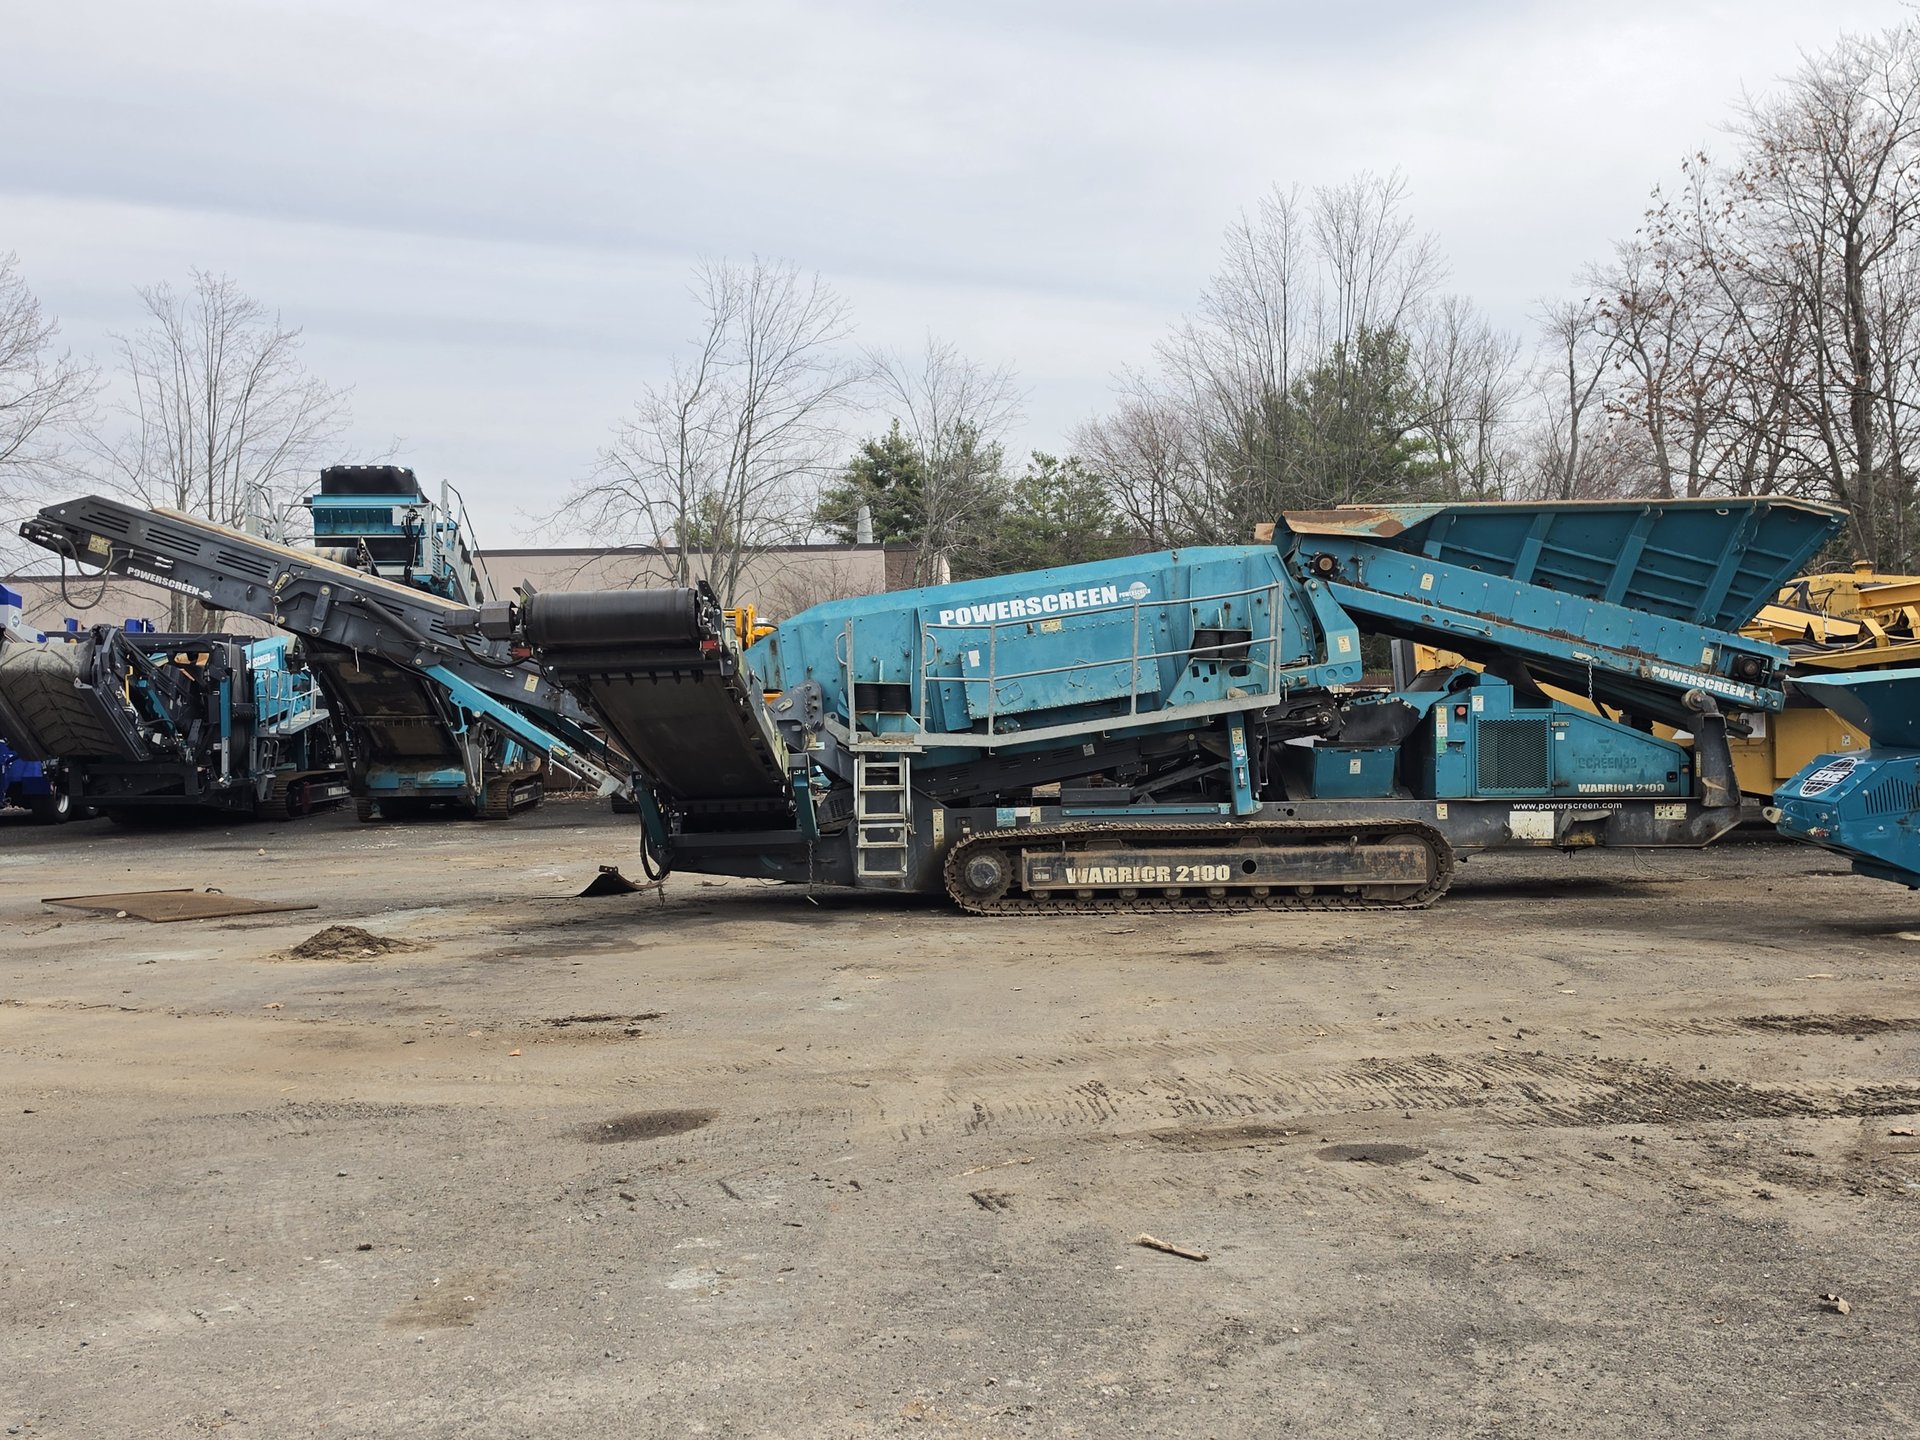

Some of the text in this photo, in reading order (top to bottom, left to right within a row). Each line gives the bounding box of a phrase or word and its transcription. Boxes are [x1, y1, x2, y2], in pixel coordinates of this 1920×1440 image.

[126, 566, 199, 596] POWERSCREEN
[939, 585, 1118, 626] POWERSCREEN
[1650, 665, 1746, 698] POWERSCREEN
[1577, 783, 1634, 793] WARRIOR
[1512, 802, 1623, 811] www.powerscreen.com
[1065, 865, 1171, 884] WARRIOR
[1175, 864, 1231, 882] 2100
